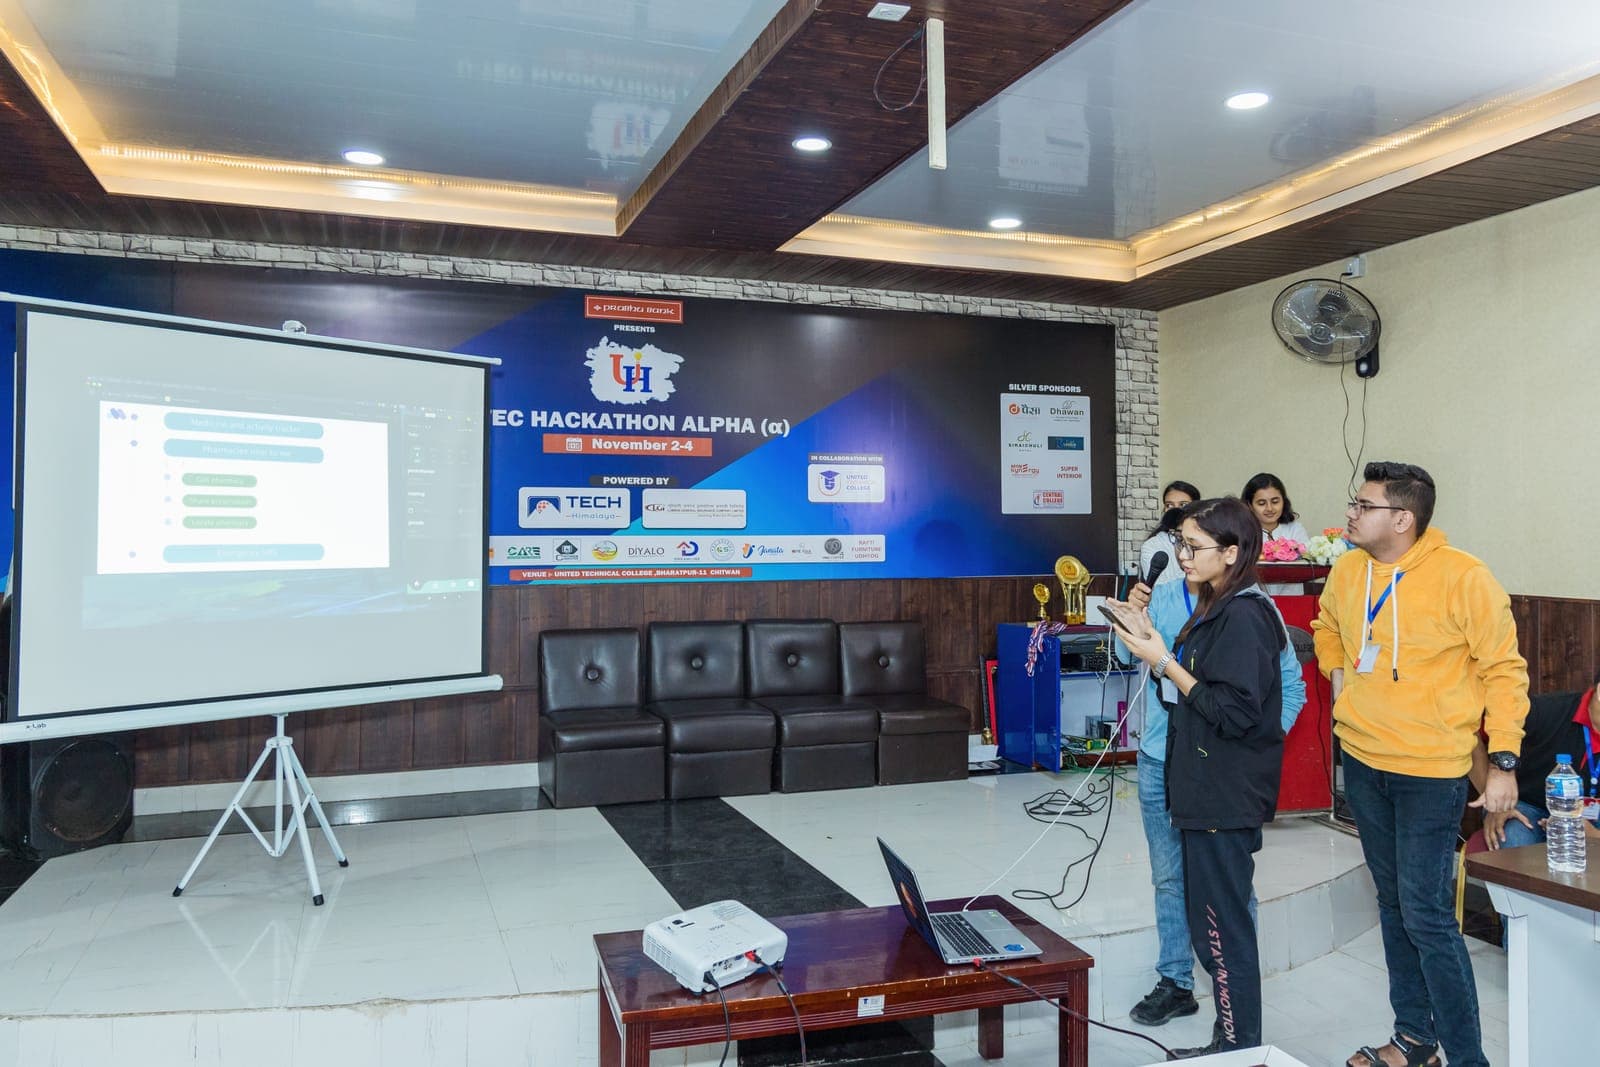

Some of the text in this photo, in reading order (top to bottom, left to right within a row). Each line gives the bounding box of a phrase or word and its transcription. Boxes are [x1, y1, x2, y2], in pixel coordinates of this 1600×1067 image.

[613, 324, 656, 333] PRESENTS
[1009, 383, 1081, 393] SILVER SPONSORS
[1050, 407, 1084, 416] Dhawan
[531, 410, 676, 432] HACKATHON
[682, 415, 756, 434] ALPHA
[591, 438, 694, 452] November 2-4
[603, 476, 669, 485] POWERED BY
[566, 496, 621, 508] TECH
[507, 546, 541, 556] CARE
[1208, 929, 1225, 967] STAY
[1217, 968, 1229, 984] IN
[1219, 985, 1238, 1044] MOTION
